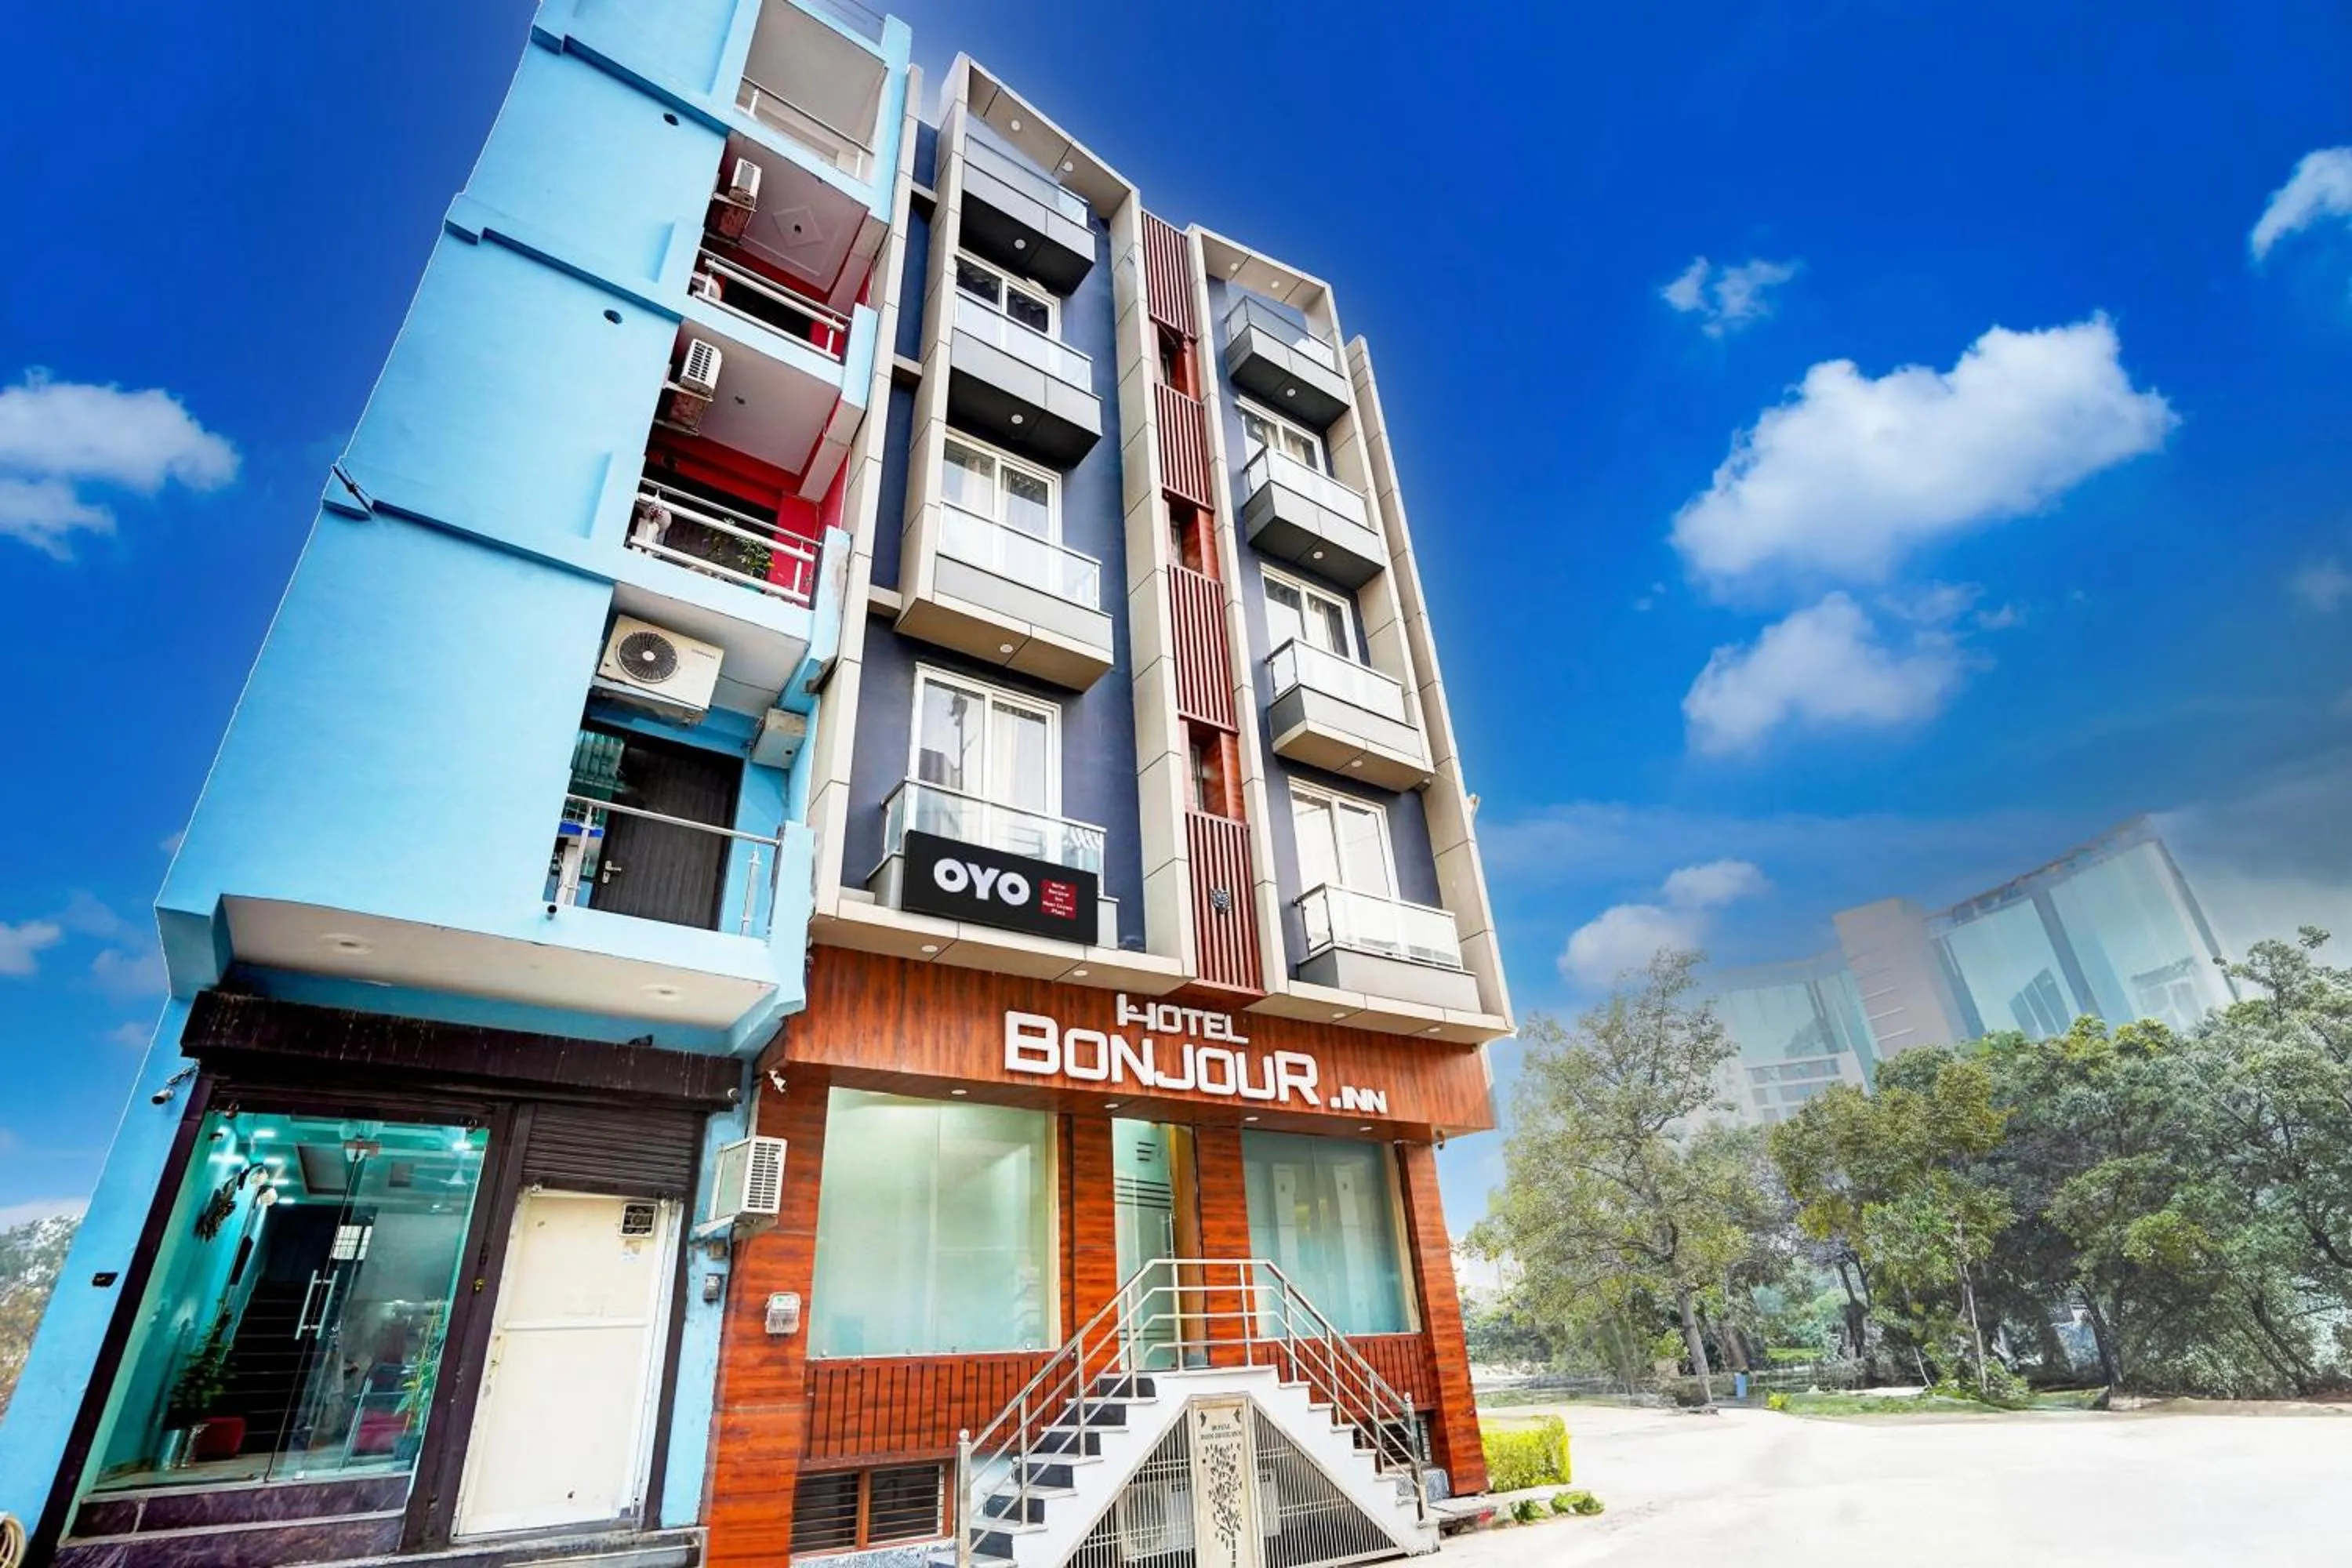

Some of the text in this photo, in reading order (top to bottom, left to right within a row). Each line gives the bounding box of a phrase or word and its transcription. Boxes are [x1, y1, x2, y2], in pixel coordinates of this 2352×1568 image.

[933, 858, 1031, 906] OYO
[1116, 993, 1249, 1044] HOTEL
[1004, 1010, 1320, 1105] BONJOUR
